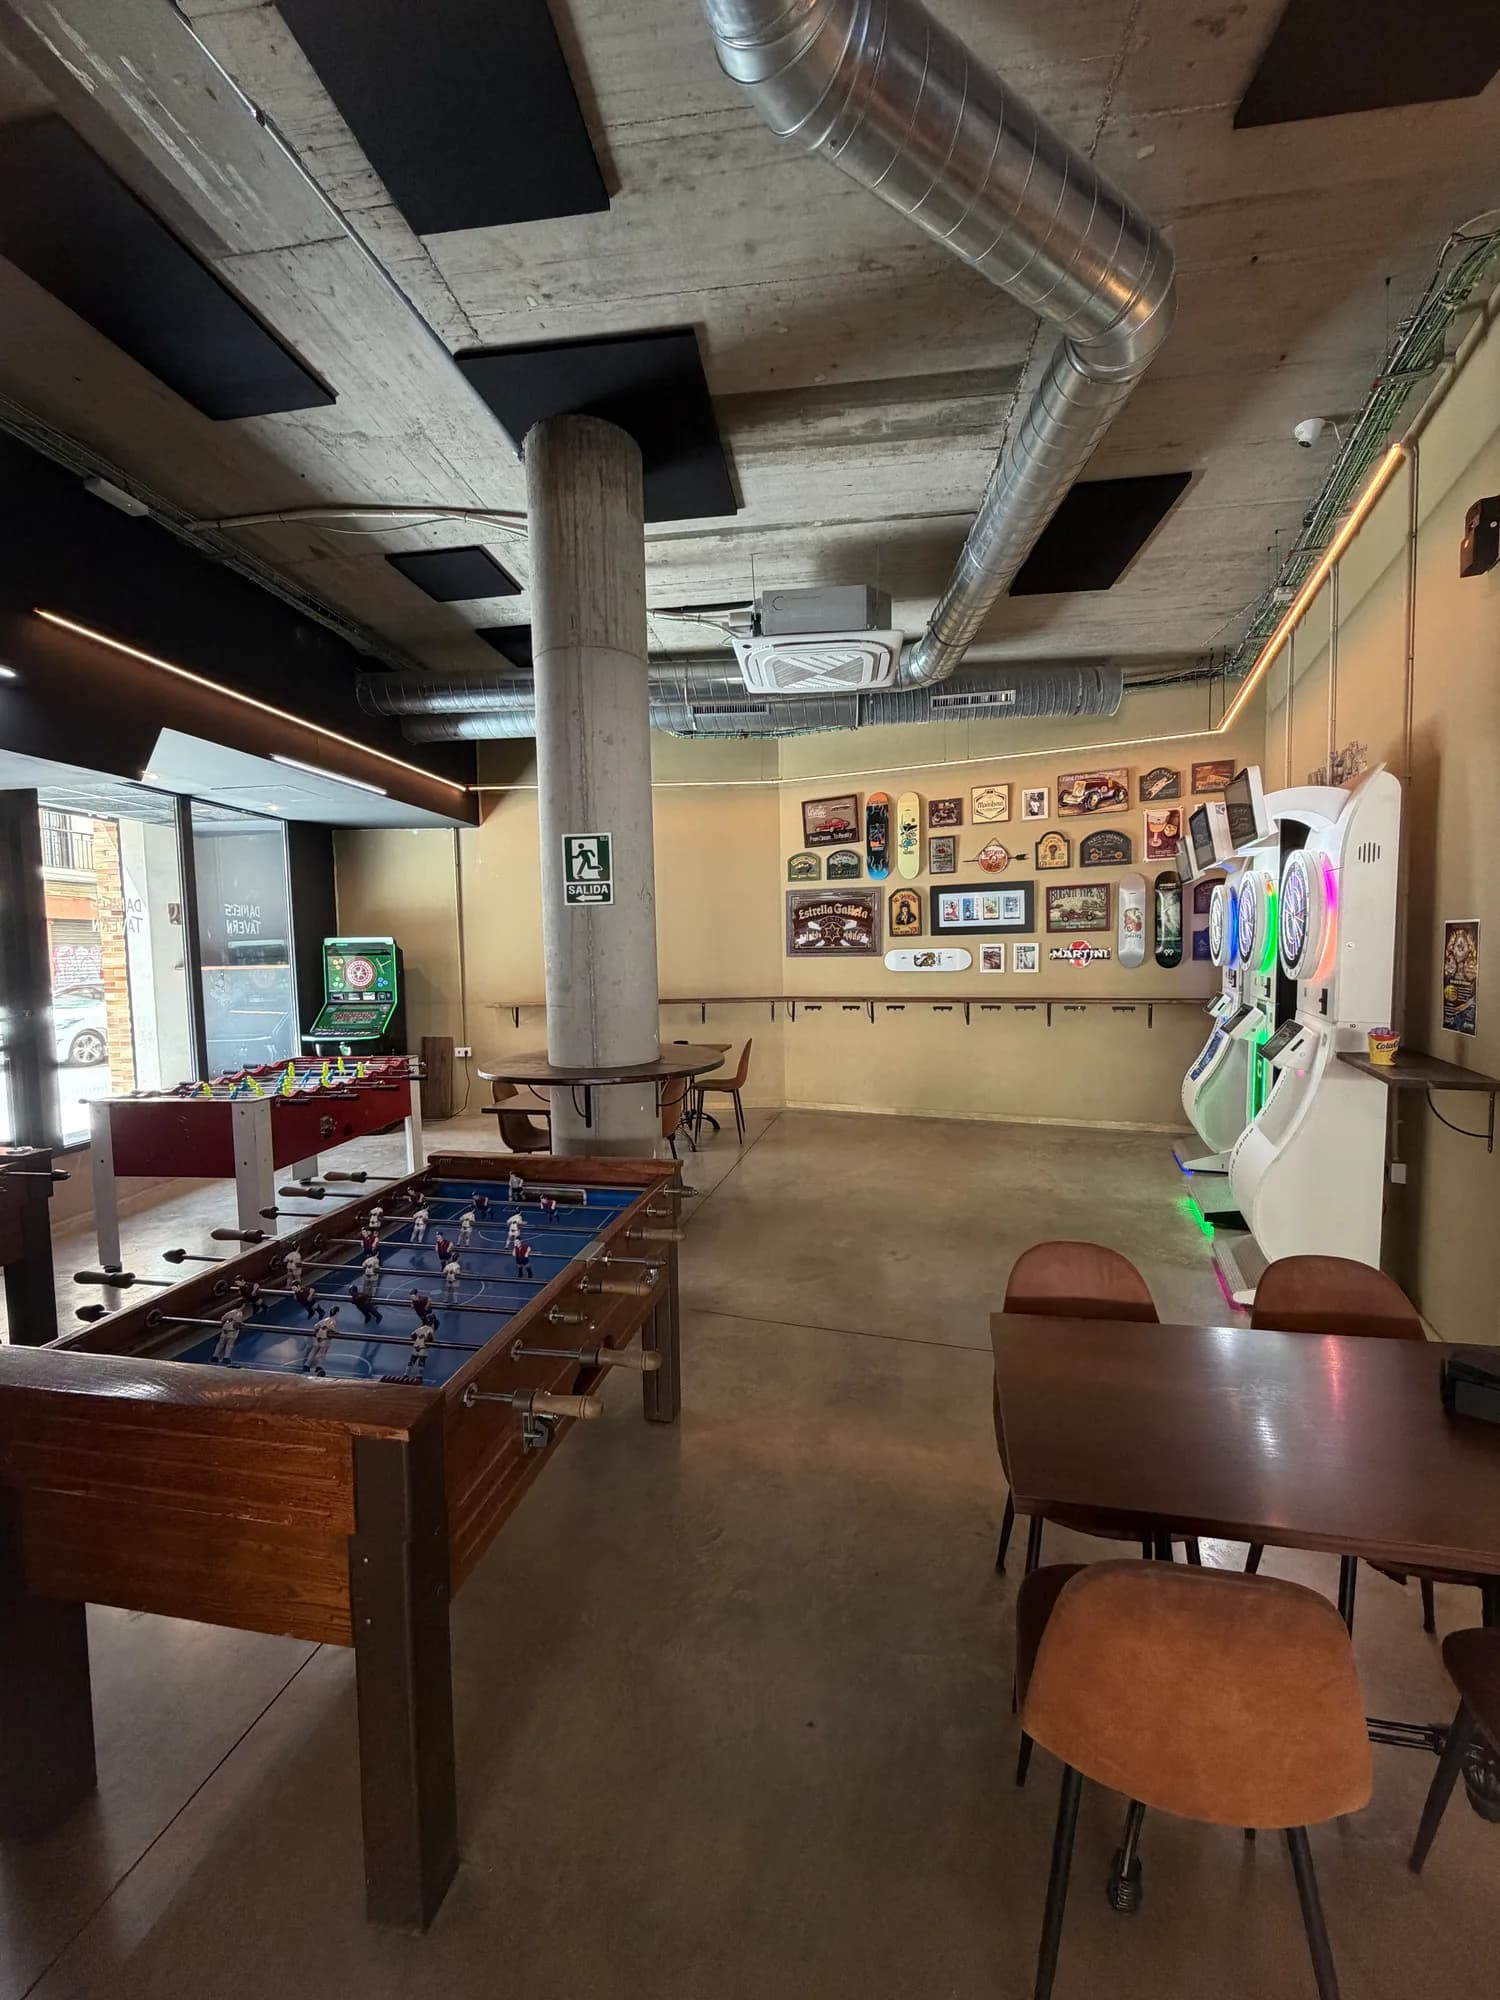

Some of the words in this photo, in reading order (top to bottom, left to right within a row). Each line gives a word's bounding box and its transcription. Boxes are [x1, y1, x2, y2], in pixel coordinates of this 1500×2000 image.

[568, 885, 609, 895] SALIDA
[798, 904, 833, 920] Estrella
[834, 903, 868, 919] Galicia
[1051, 948, 1109, 960] MARTINI
